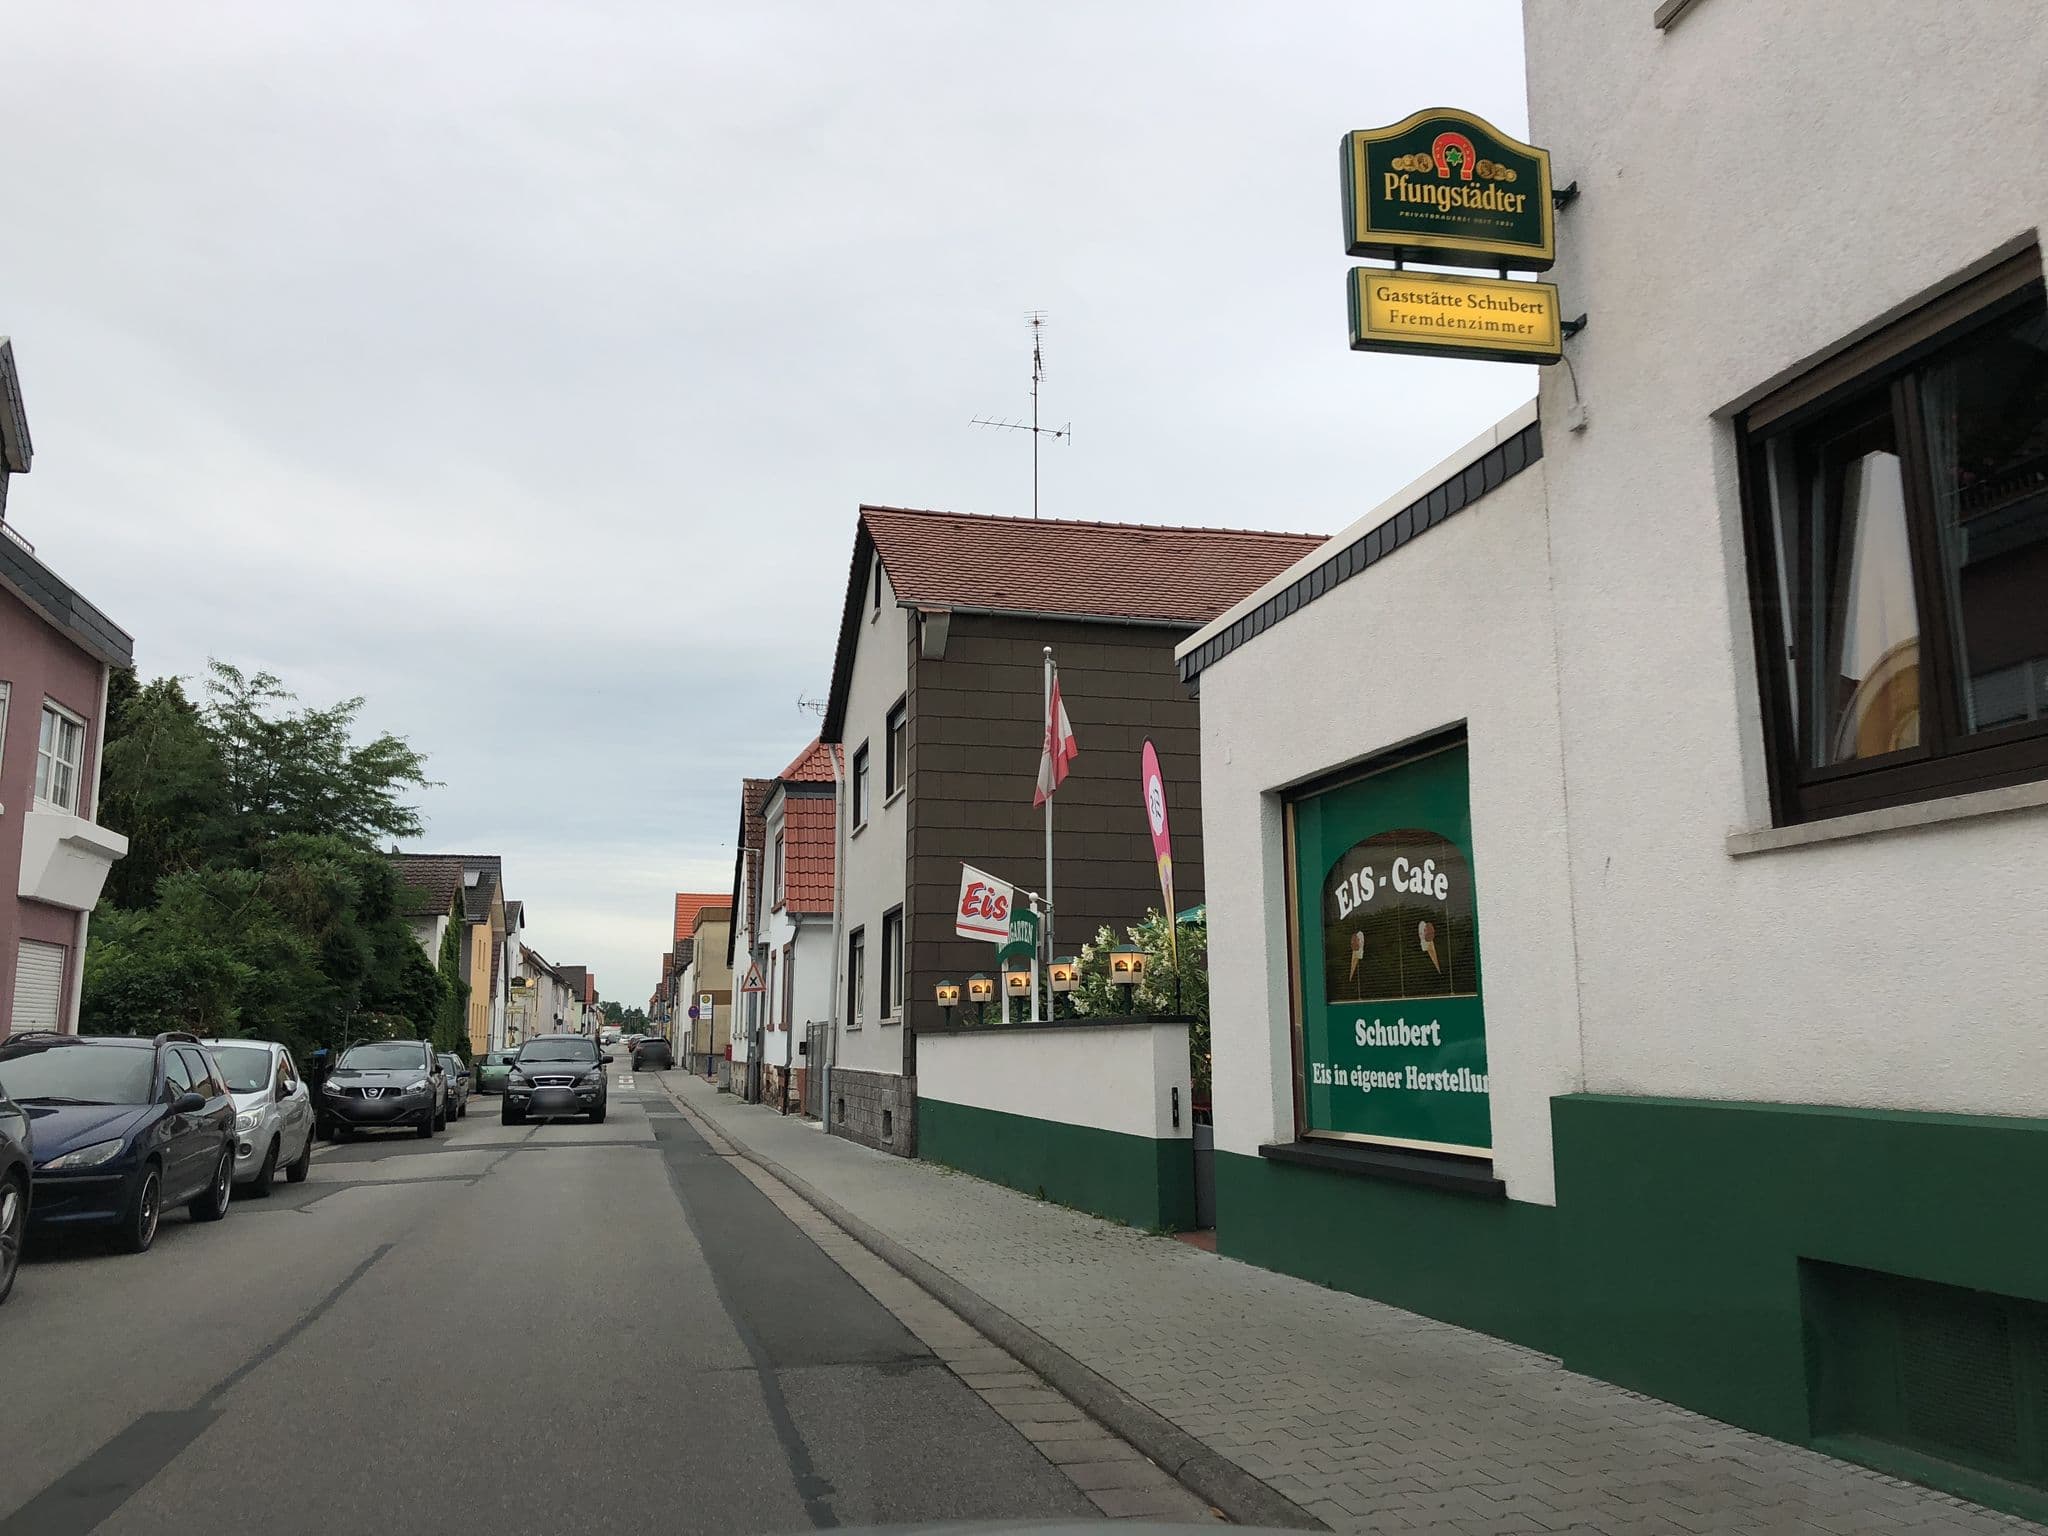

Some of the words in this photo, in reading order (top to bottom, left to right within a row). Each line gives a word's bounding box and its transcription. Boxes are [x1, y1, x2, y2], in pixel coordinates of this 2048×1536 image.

[1383, 172, 1526, 214] Pfungstädter
[1376, 286, 1462, 307] Gaststätte
[1467, 293, 1544, 315] Schubert
[1389, 309, 1535, 335] Fremdenzimmer
[961, 882, 1009, 921] Eis
[1335, 866, 1375, 920] EIS
[1392, 857, 1448, 900] Cafe
[1355, 1018, 1441, 1046] Schubert
[1312, 1063, 1332, 1085] Eis
[1334, 1064, 1348, 1086] in
[1350, 1064, 1403, 1093] eigener
